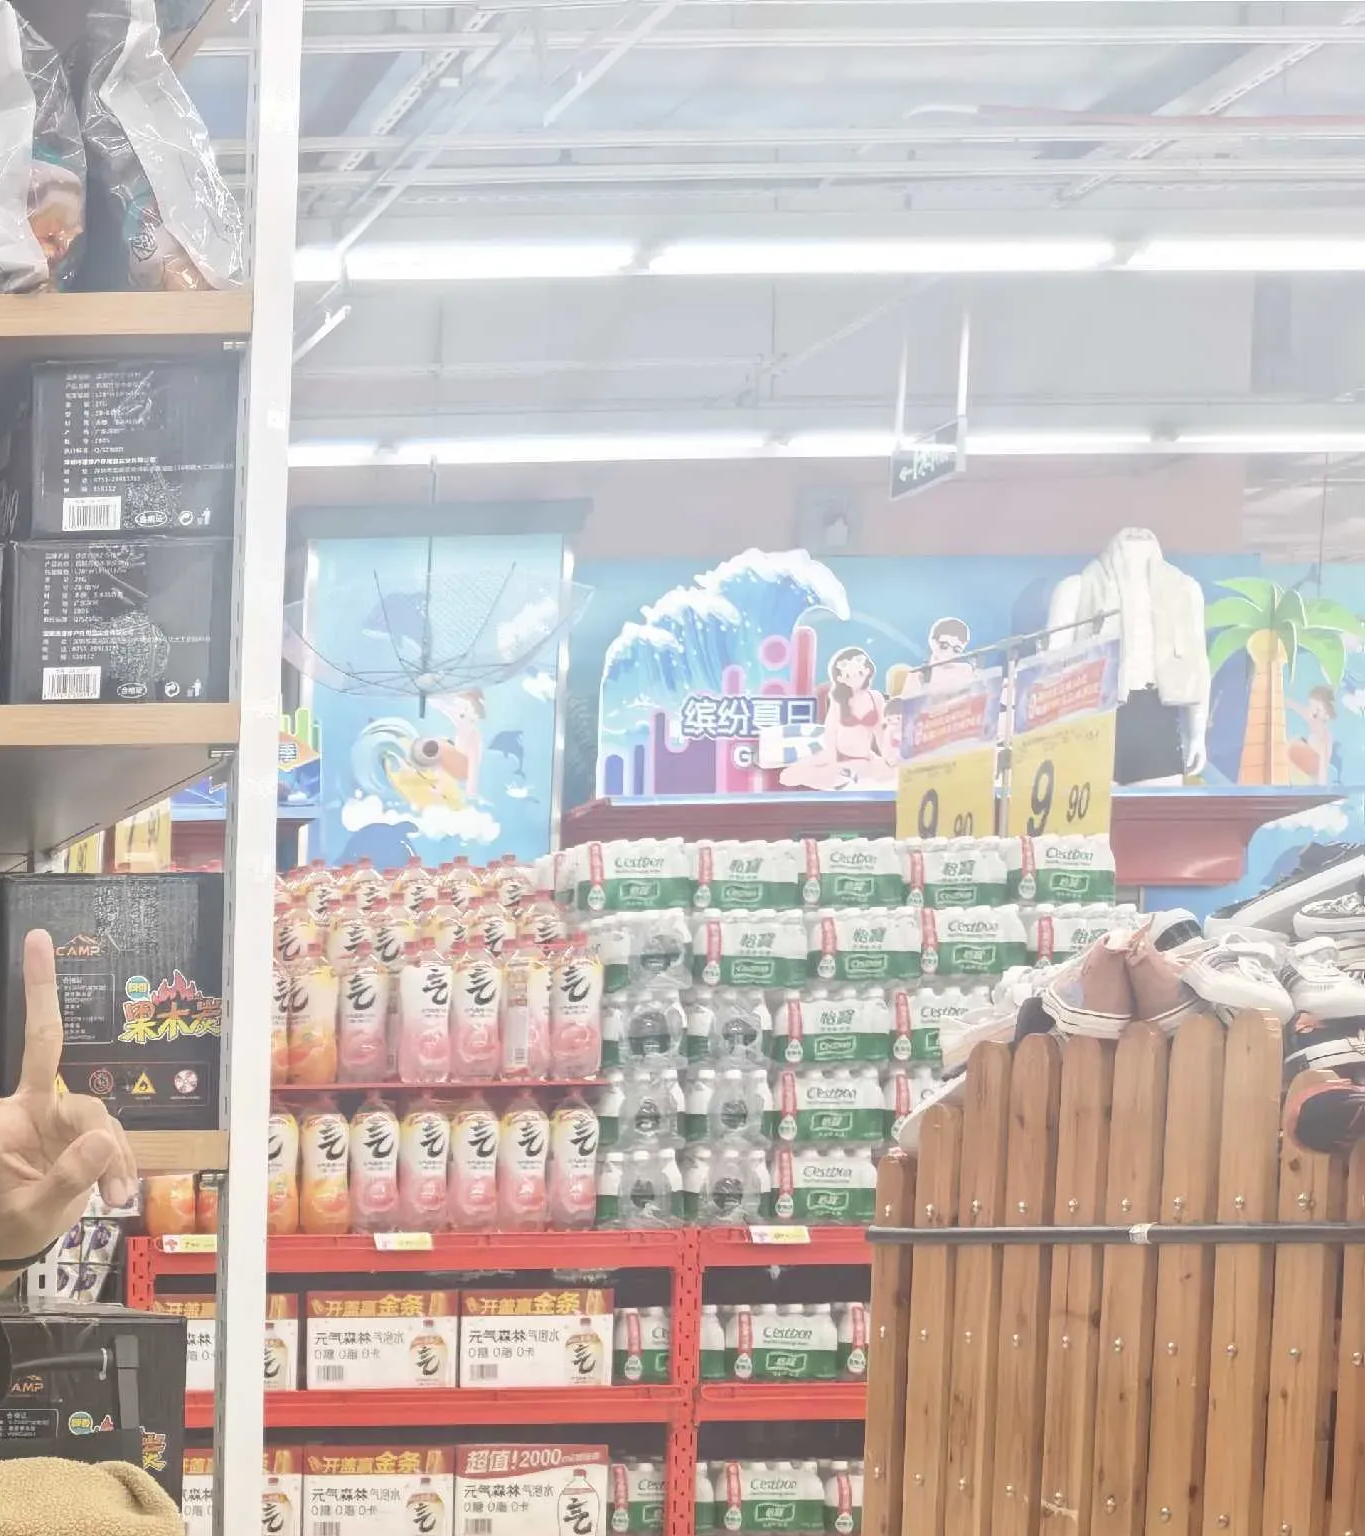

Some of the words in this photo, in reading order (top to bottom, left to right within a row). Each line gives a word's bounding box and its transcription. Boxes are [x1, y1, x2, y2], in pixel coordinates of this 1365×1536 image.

[681, 698, 817, 735] 缤纷夏日
[1026, 759, 1055, 838] 9
[1067, 781, 1091, 823] 90
[56, 944, 101, 958] CAMP
[314, 1331, 372, 1346] 元气森林
[468, 1329, 526, 1344] 元气森林
[11, 1382, 44, 1393] AMP
[311, 1487, 369, 1502] 元气森林
[463, 1484, 521, 1499] 元气森林
